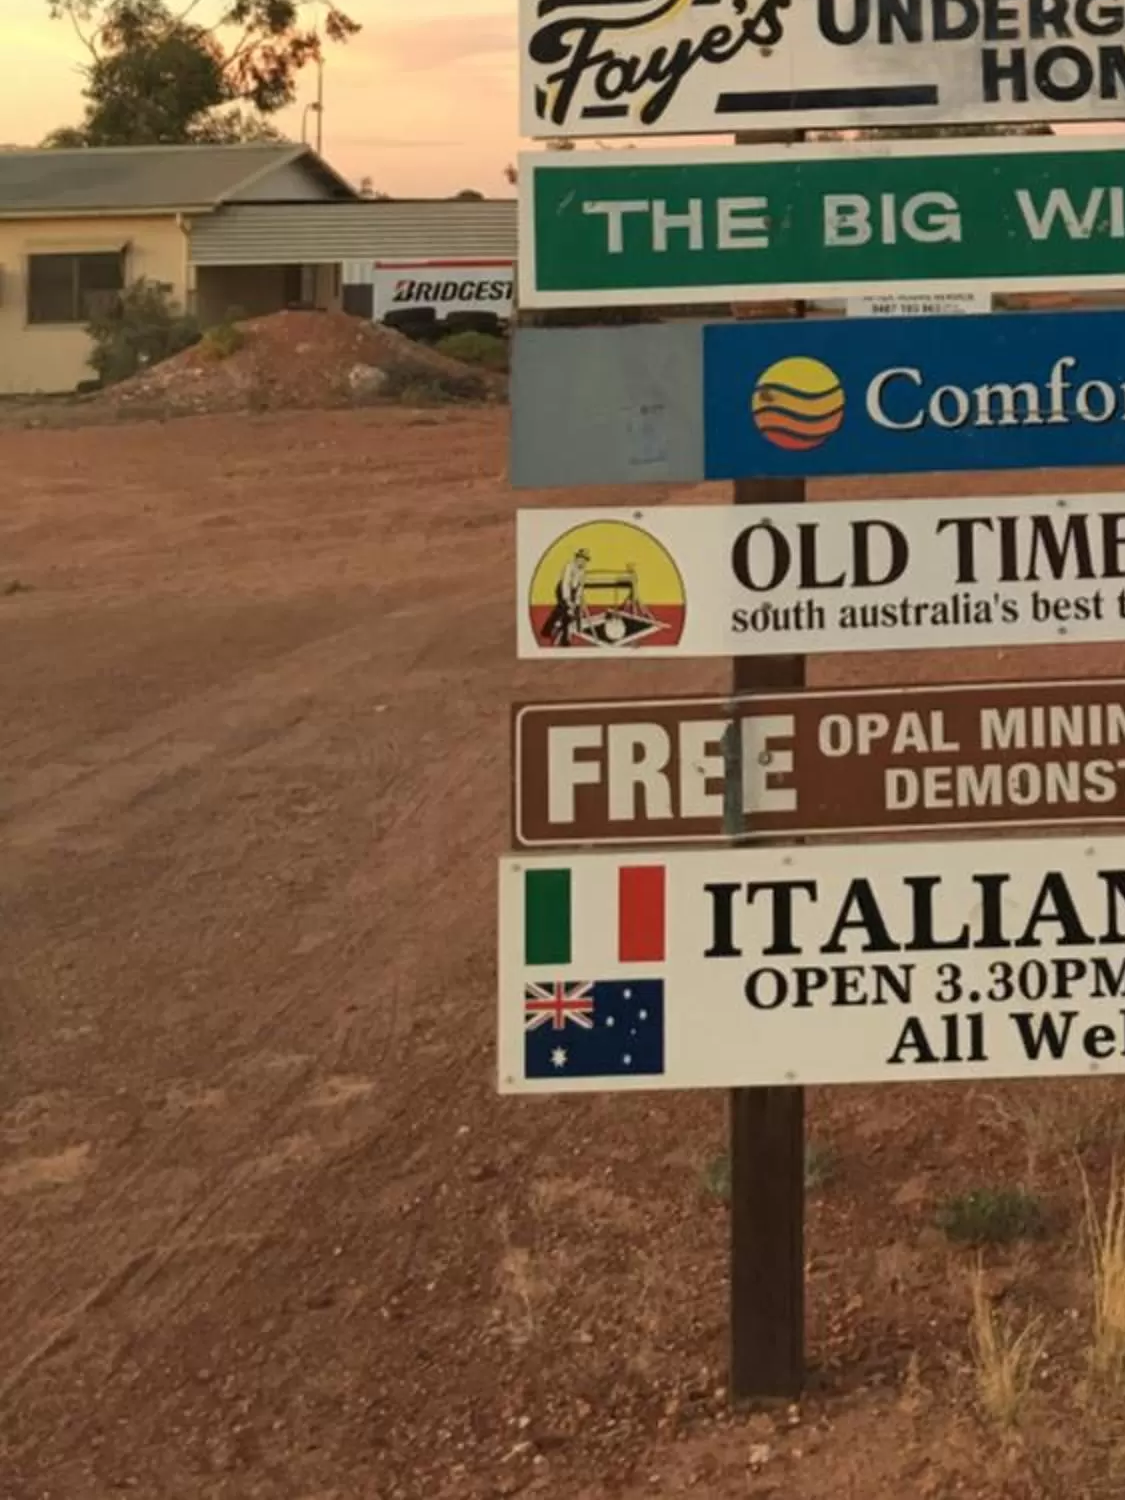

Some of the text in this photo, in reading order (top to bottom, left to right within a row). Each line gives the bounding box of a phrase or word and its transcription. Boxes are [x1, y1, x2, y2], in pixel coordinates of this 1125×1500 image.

[583, 196, 769, 254] THE
[823, 191, 963, 247] BIG
[731, 520, 910, 593] OLD
[731, 600, 825, 634] south
[839, 592, 1019, 629] australia's
[1032, 589, 1103, 623] best
[547, 714, 798, 824] FREE
[818, 710, 960, 758] OPAL
[744, 963, 916, 1010] OPEN
[886, 1014, 988, 1065] All
